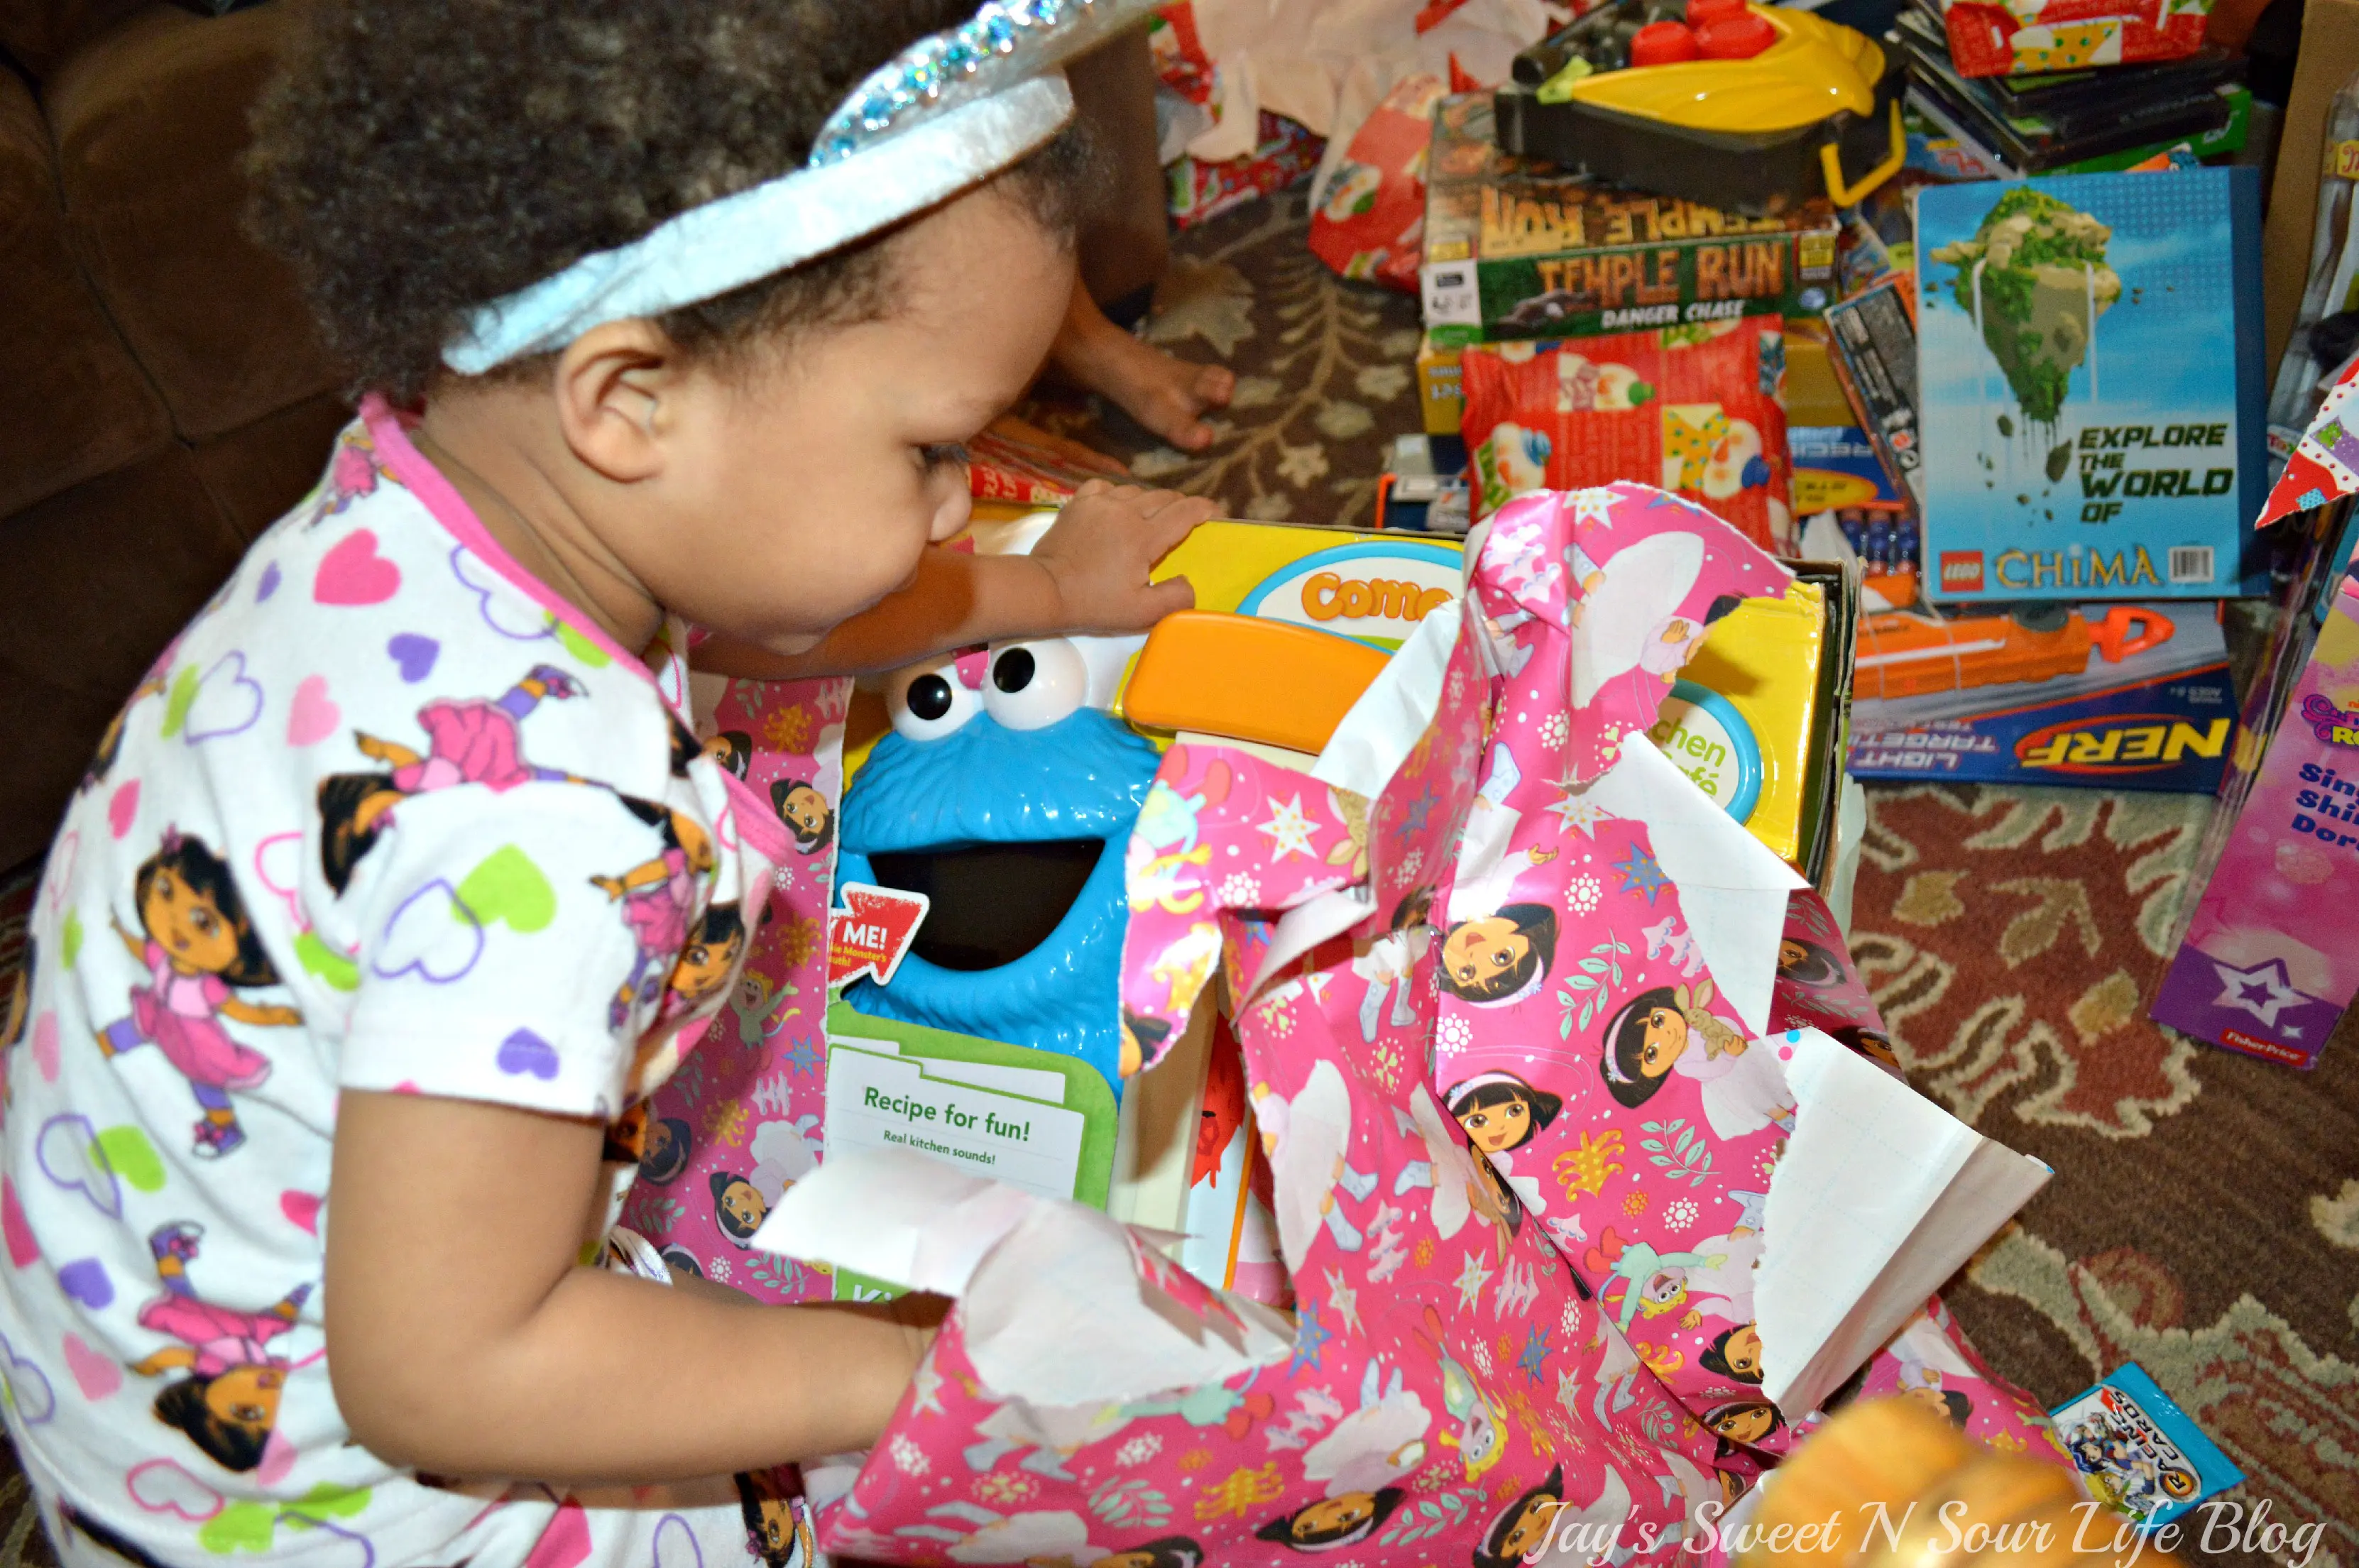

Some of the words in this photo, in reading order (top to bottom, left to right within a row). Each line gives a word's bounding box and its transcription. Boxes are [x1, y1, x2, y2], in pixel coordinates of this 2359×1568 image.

[1480, 185, 1586, 251] RUN
[1536, 248, 1680, 308] TEMPLE
[1696, 241, 1784, 301] RUN
[1602, 305, 1680, 329] DANGER
[1685, 299, 1746, 322] CHASE
[2078, 422, 2229, 449] EXPLORE
[2079, 451, 2125, 471] THE
[2080, 467, 2234, 498] WORLD
[2080, 501, 2124, 524] OF
[1943, 562, 1981, 580] LEGO
[1854, 750, 1959, 769] LIGHT
[2020, 718, 2232, 769] NERF
[1662, 750, 1719, 799] fé
[2299, 762, 2359, 805] Sin
[2292, 813, 2359, 852] Dor
[843, 921, 887, 950] ME!
[843, 945, 887, 963] Monster's
[864, 1087, 937, 1122] Recipe
[944, 1104, 978, 1129] for
[985, 1112, 1030, 1141] fun!
[884, 1130, 907, 1144] Real
[909, 1135, 950, 1155] kitchen
[953, 1147, 996, 1166] sounds!
[2113, 1391, 2179, 1461] CARDS
